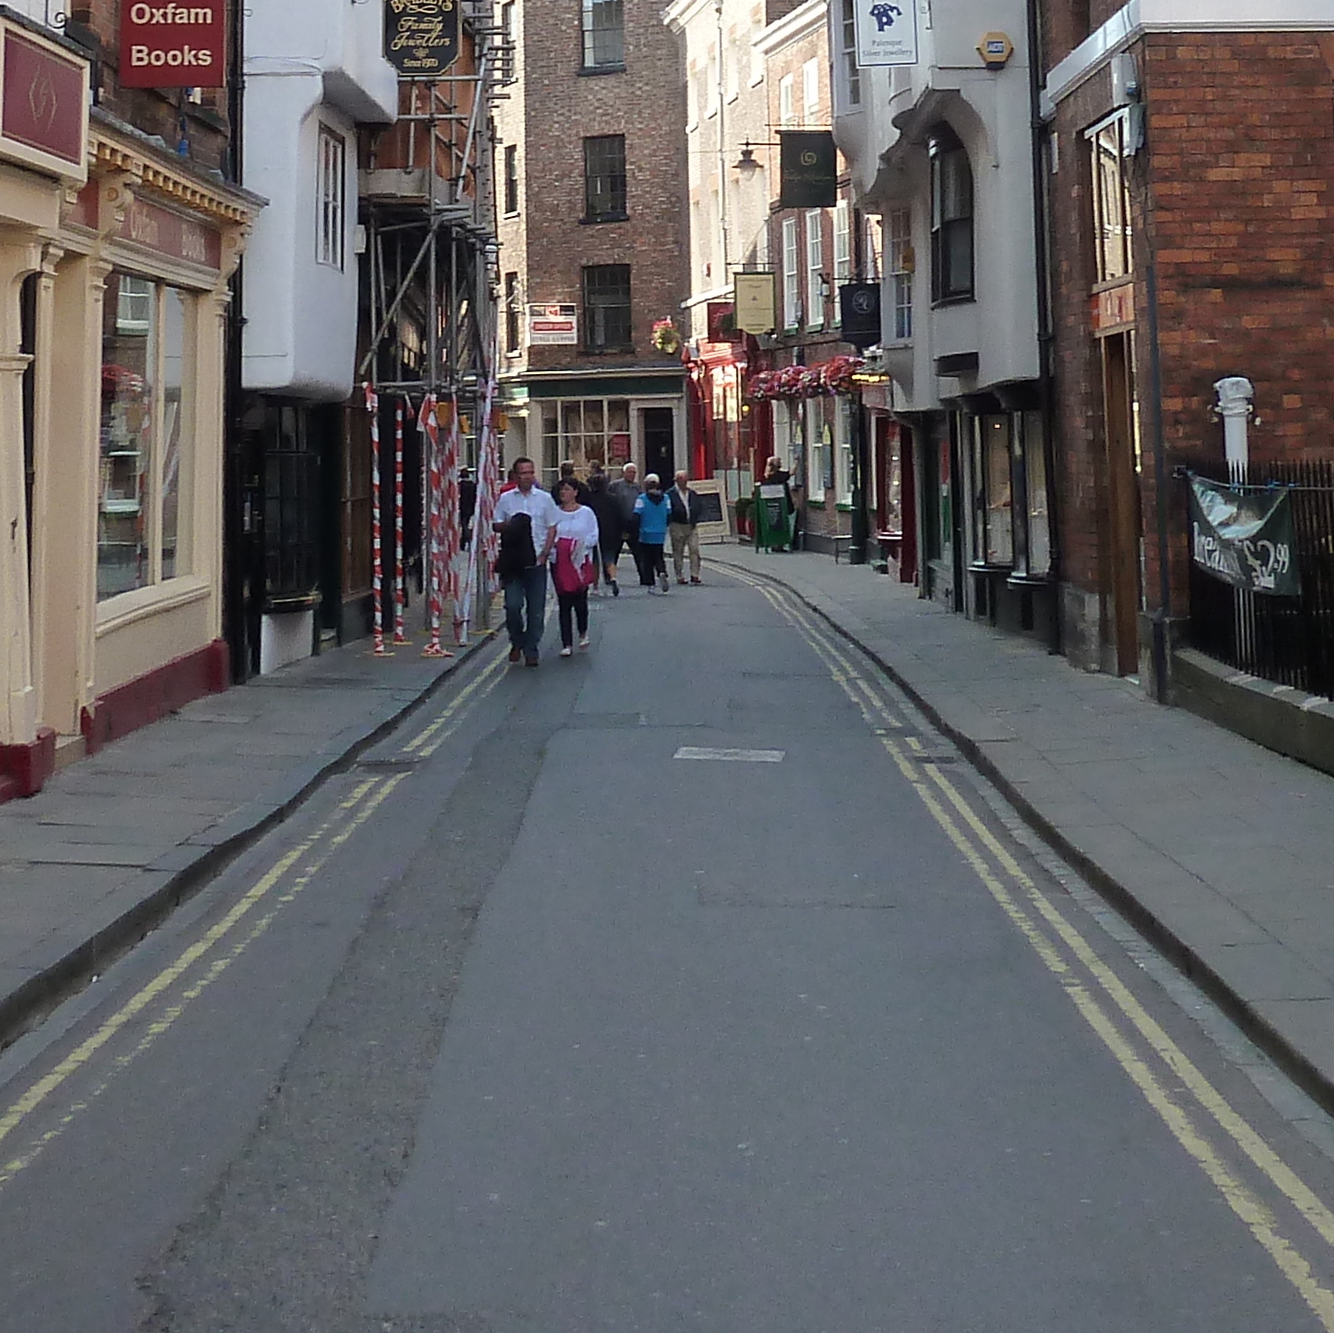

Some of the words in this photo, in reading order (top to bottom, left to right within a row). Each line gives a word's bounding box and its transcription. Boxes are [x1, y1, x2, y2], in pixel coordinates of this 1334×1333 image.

[130, 3, 212, 24] Oxfam
[398, 16, 443, 35] Family
[390, 32, 451, 50] Jewellers
[131, 45, 212, 66] Books
